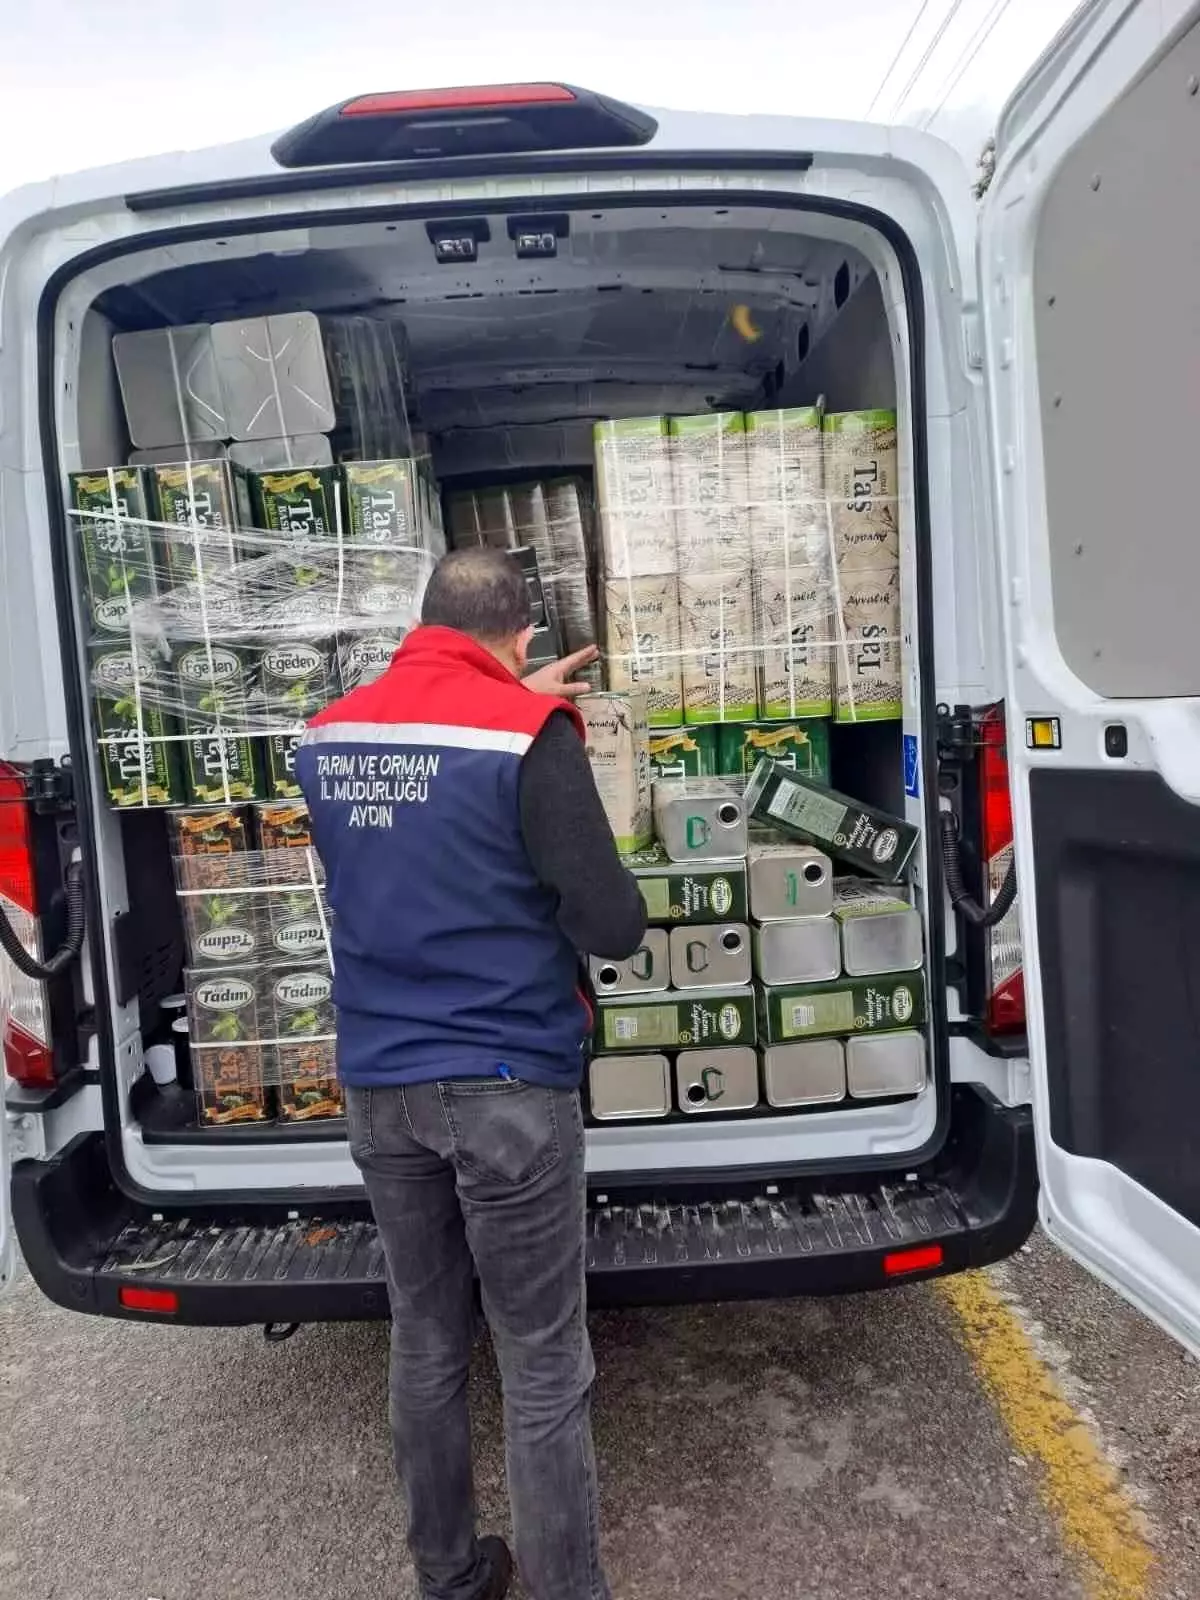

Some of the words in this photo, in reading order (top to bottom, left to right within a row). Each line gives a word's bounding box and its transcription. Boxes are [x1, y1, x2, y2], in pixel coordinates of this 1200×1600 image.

[847, 460, 877, 513] Taş
[621, 601, 663, 613] Avalık
[352, 647, 394, 667] Egede
[857, 625, 887, 675] Taş
[101, 662, 149, 681] Egedn
[268, 655, 316, 672] Egeden
[317, 755, 355, 776] TARIM
[358, 755, 378, 776] VE
[380, 754, 440, 776] ORMAN
[320, 776, 331, 800] İL
[334, 775, 428, 802] MÜDÜRLÜĞÜ
[348, 805, 393, 827] AYDIN
[202, 989, 248, 1003] Tadım
[280, 984, 328, 998] Tadım
